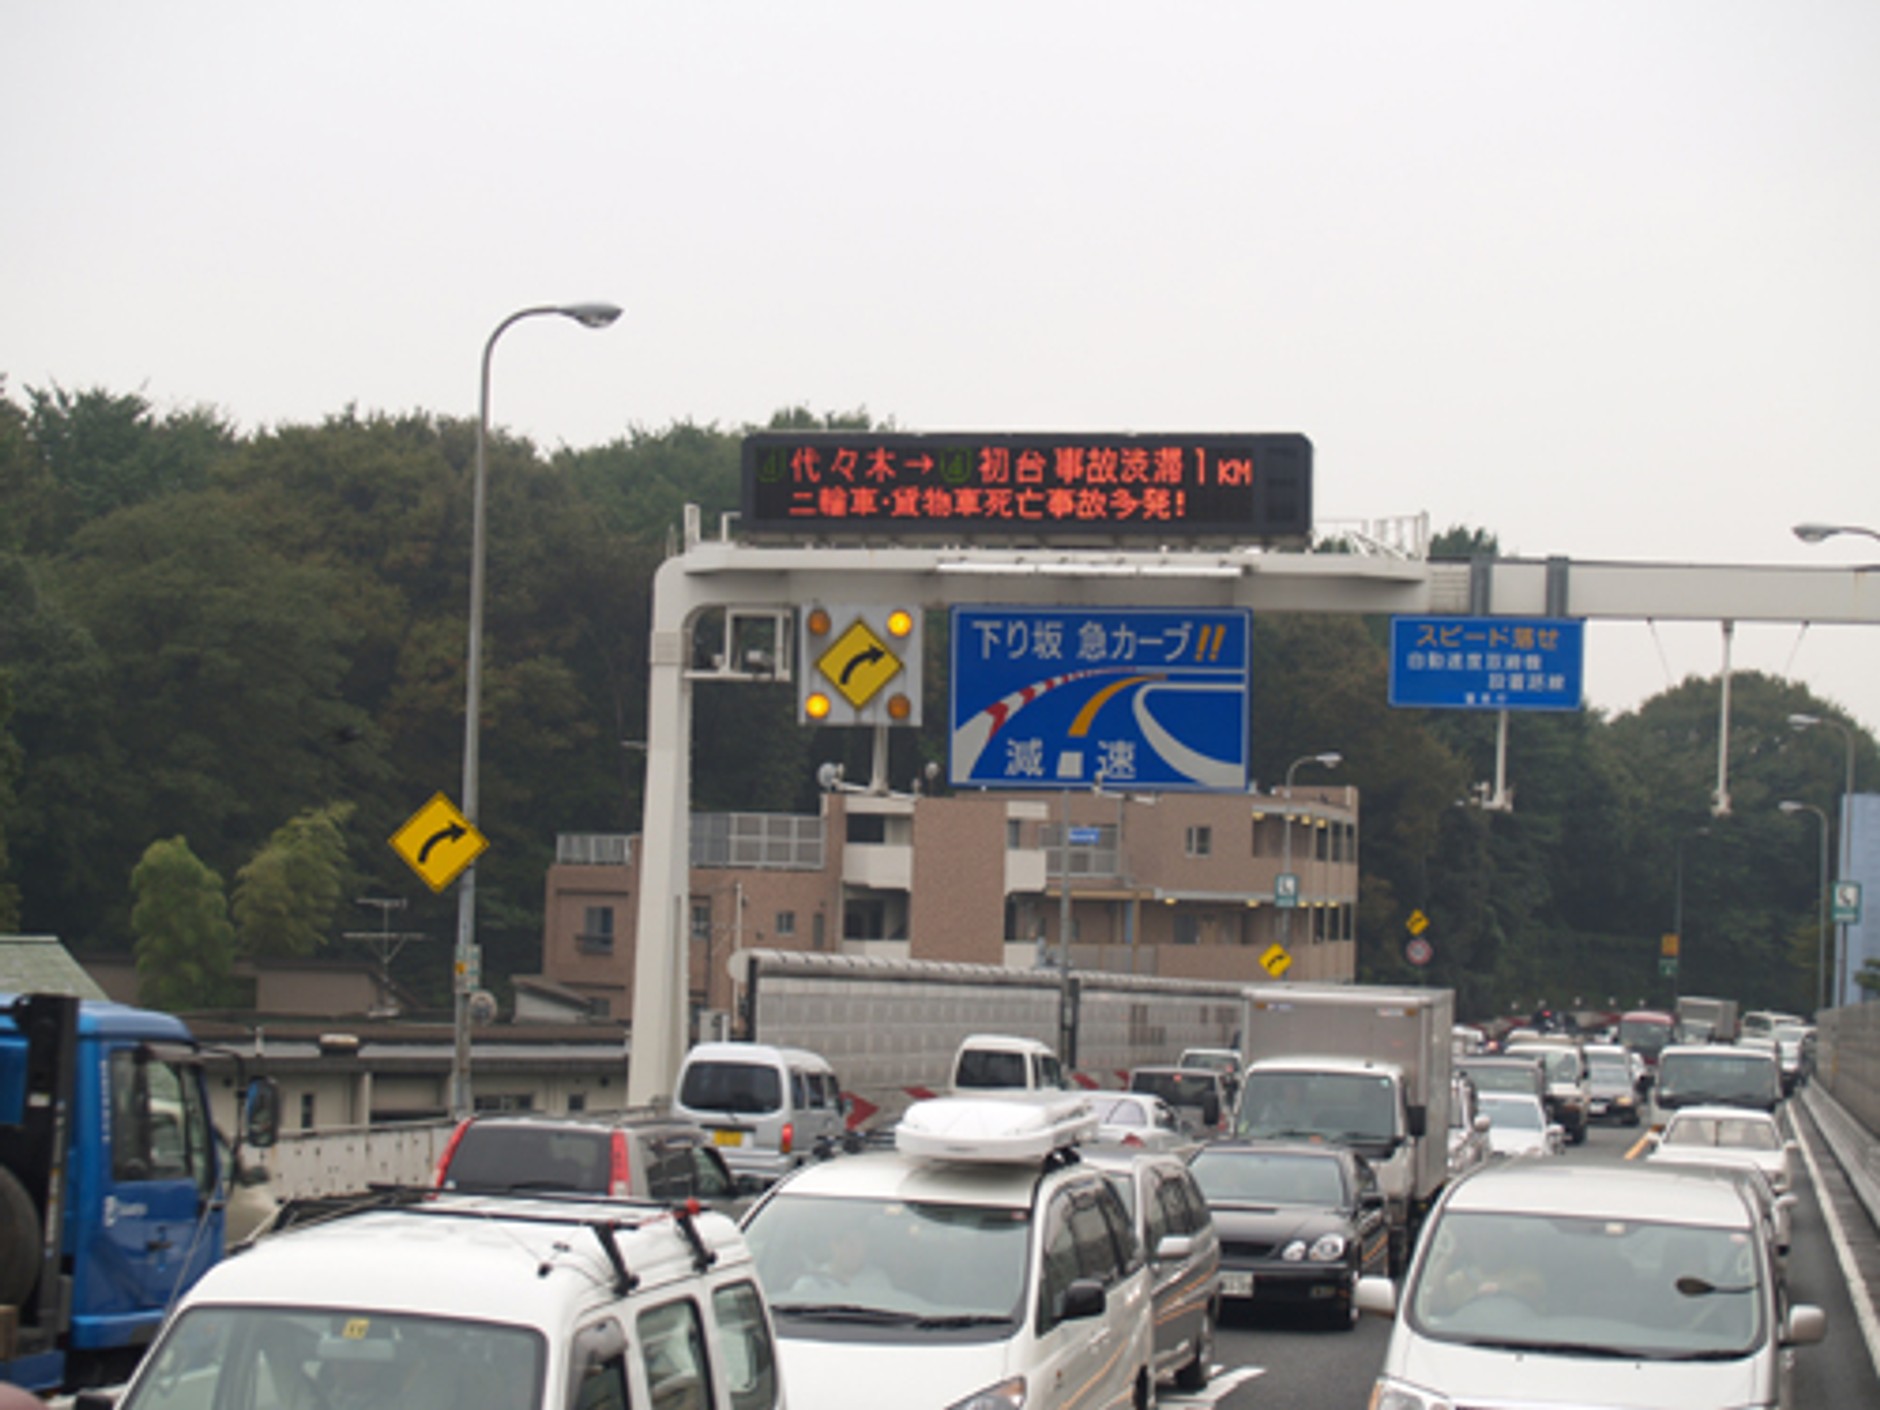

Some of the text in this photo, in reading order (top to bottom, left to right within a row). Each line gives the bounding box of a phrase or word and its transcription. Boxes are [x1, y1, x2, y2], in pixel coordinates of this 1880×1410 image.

[790, 446, 897, 483] 代々木
[979, 446, 1047, 484] 初台
[972, 620, 1064, 660] 下り坂
